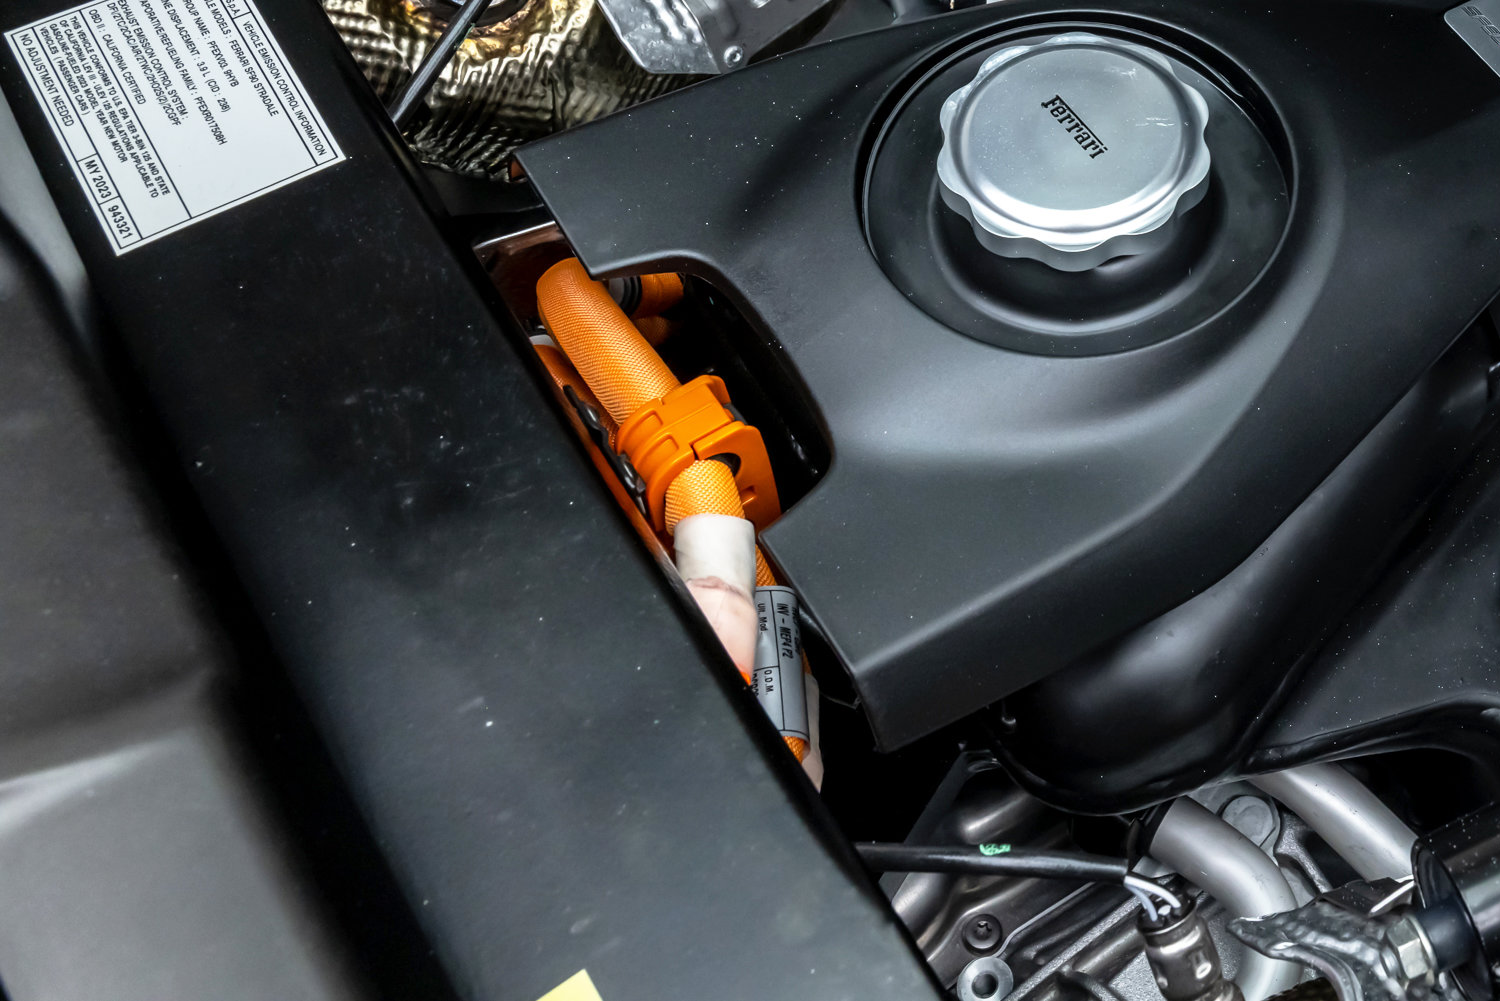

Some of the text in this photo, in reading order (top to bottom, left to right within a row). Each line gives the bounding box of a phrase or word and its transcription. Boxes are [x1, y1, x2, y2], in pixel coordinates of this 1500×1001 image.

[59, 19, 70, 28] OF
[166, 8, 200, 56] DISPLACEMENT
[196, 61, 208, 72] 3.9
[202, 70, 210, 78] L
[193, 16, 210, 37] NAME
[63, 28, 87, 63] CALIFORNIA
[88, 8, 103, 24] OBD
[101, 33, 128, 72] CALIFORNIA
[122, 71, 146, 105] CERTIFIED
[210, 7, 232, 35] MODELS
[228, 39, 250, 67] FERRARI
[244, 66, 259, 83] SF90
[253, 82, 279, 117] STRADALE
[19, 33, 75, 127] NO ADJUSTMENT NEEDED
[39, 26, 59, 55] VEHICLES
[56, 59, 80, 95] PASSENGER
[74, 94, 89, 112] CARS
[81, 61, 94, 73] LEV
[132, 26, 157, 59] EMISSION
[150, 58, 173, 90] CONTROL
[167, 89, 189, 116] SYSTEM
[178, 68, 198, 91] FAMILY
[49, 23, 128, 163] GASOLINE-FUELED 2023 MODEL YEAR NEW MOTOR
[69, 15, 171, 196] THIS VEHICLE CONFORMS TO U.S. EPA TIER 3-BIN 125 AND STATE
[93, 83, 107, 99] ULEV
[102, 99, 113, 111] 125
[242, 20, 327, 156] VEHICLE EMISSION CONTROL INFORMATION
[107, 110, 135, 152] REGULATIONS
[1040, 94, 1108, 159] Ferrari
[84, 159, 112, 199] MY 2023
[128, 151, 154, 189] APPLICABLE
[148, 187, 159, 198] TO
[107, 204, 133, 239] 943321
